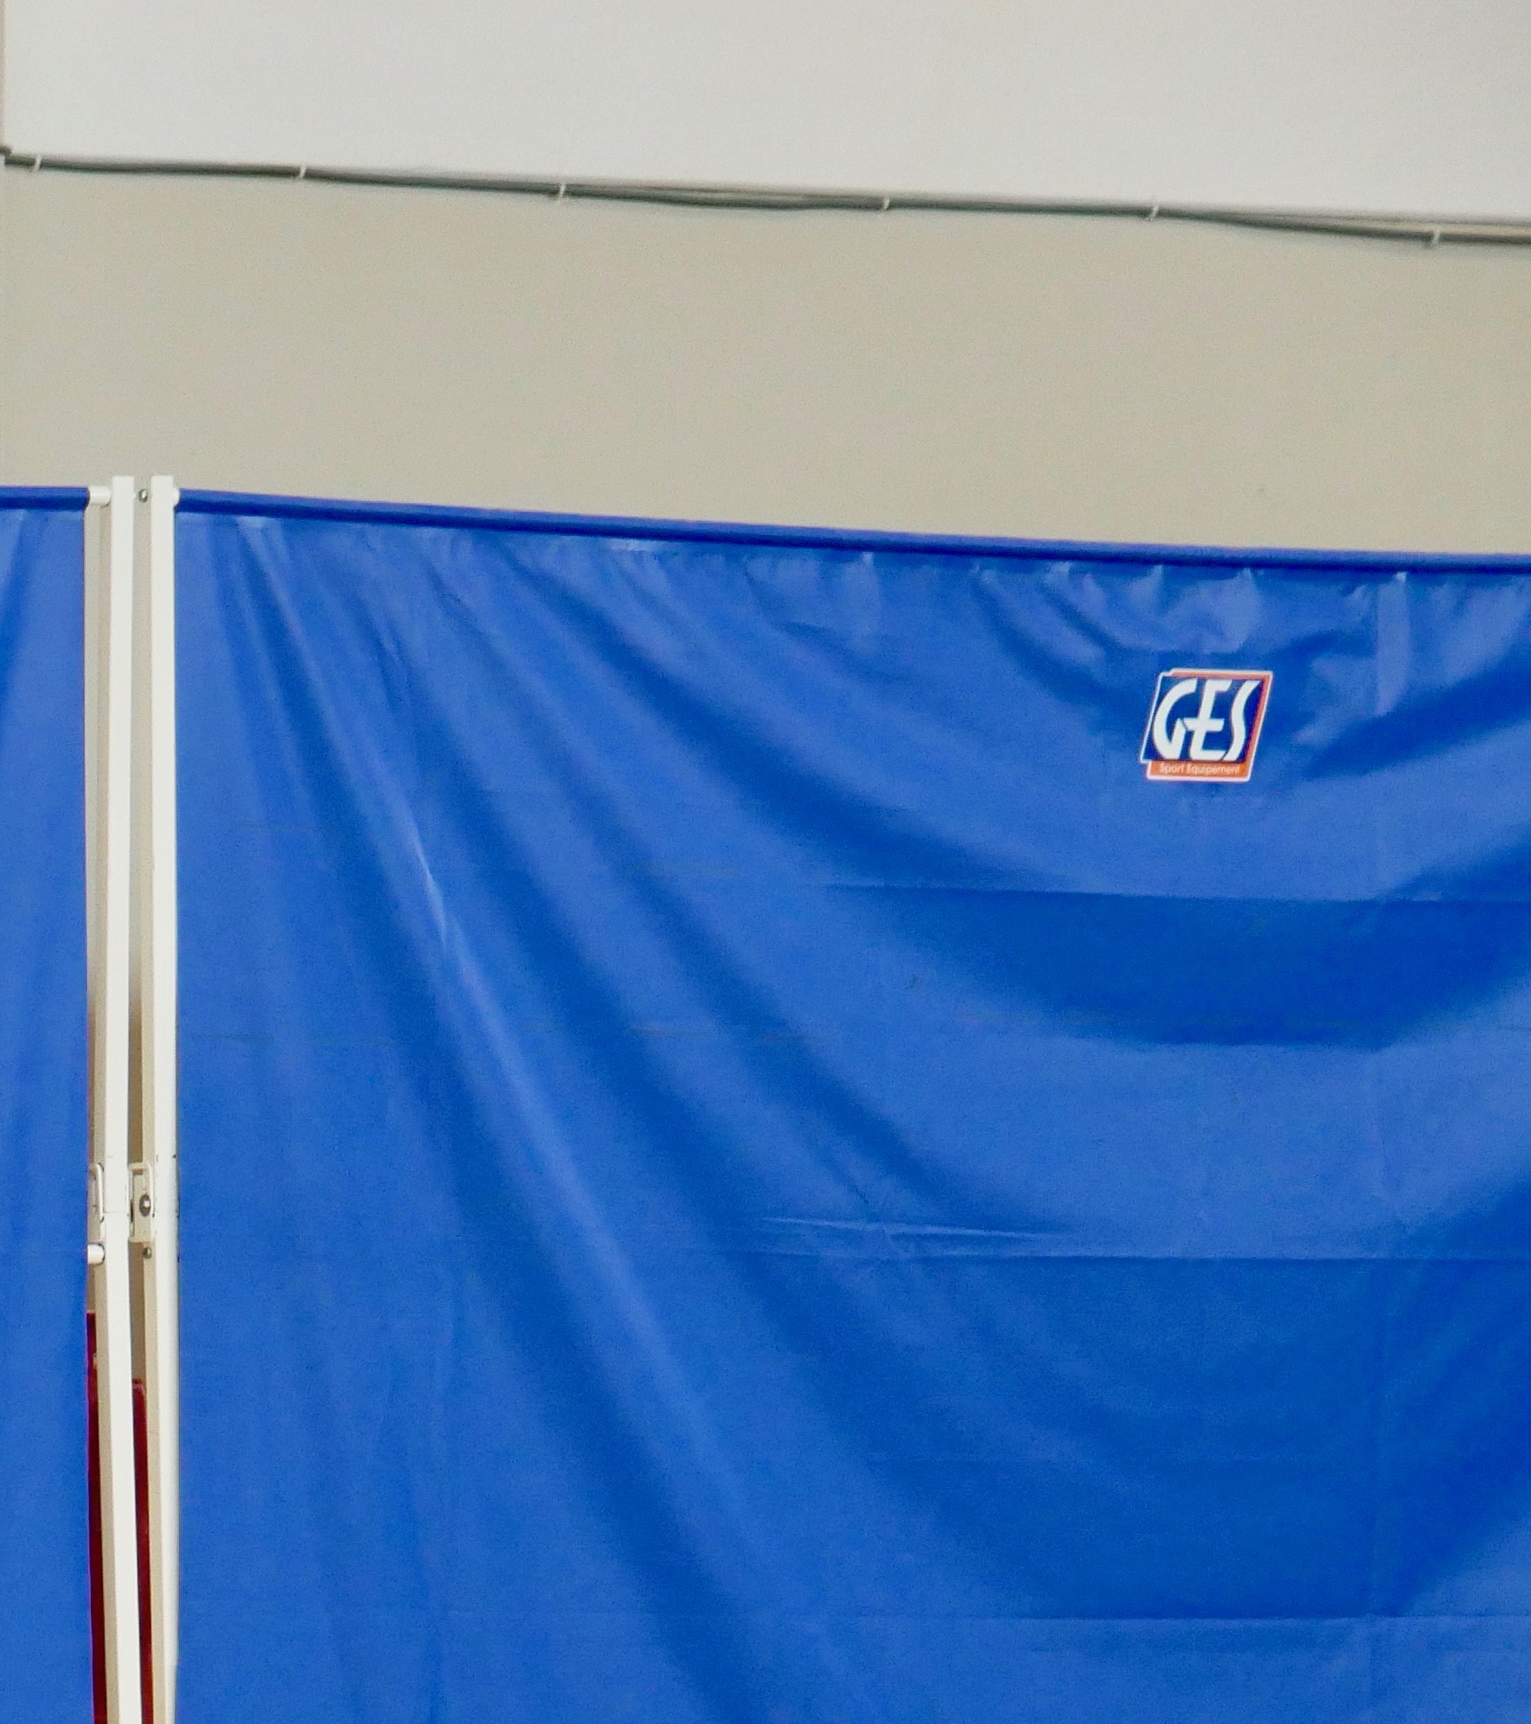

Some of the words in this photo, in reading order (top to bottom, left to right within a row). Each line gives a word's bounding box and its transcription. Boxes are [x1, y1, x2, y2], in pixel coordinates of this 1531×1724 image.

[1153, 678, 1261, 761] GES
[1159, 761, 1185, 775] Sport
[1186, 761, 1241, 775] Equipement
